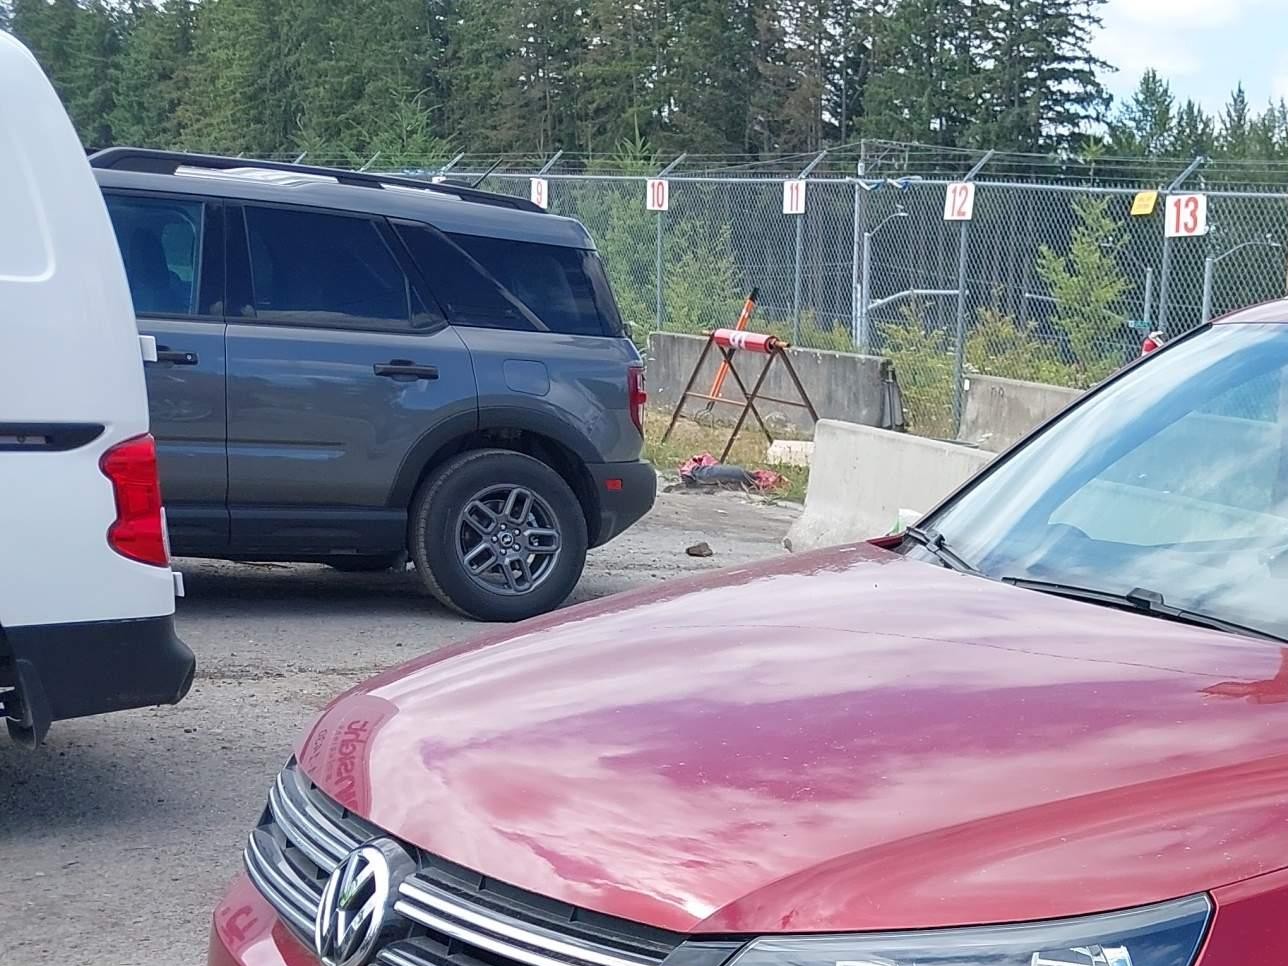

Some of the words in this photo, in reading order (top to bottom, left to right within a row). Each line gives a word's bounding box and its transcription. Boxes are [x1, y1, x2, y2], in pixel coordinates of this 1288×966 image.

[536, 183, 543, 205] 9
[651, 182, 664, 208] 10
[789, 185, 801, 211] 11
[951, 185, 968, 217] 12
[1173, 197, 1199, 233] 13
